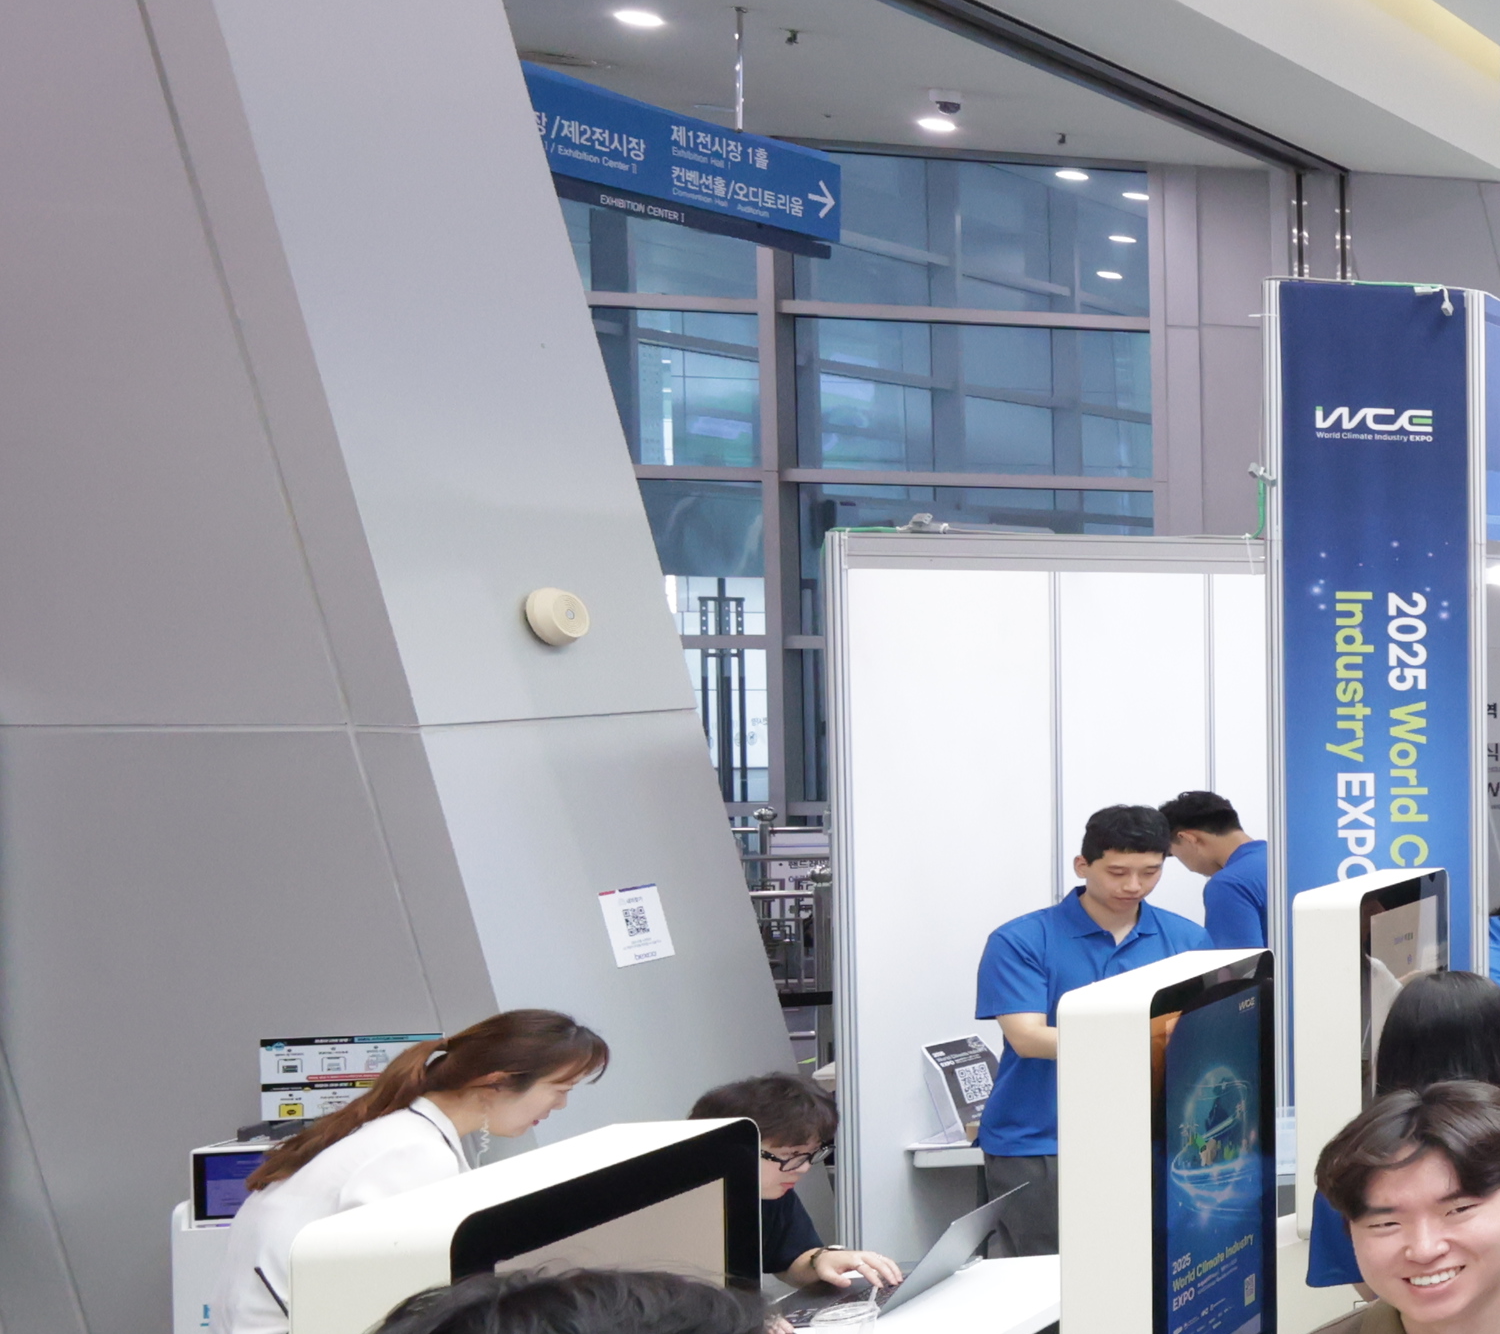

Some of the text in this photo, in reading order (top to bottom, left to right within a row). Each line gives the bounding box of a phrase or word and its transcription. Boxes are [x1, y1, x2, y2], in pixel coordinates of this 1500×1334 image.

[557, 144, 629, 172] Exhibition Center
[670, 125, 743, 163] 제1전시장
[747, 146, 769, 170] 1홀
[600, 194, 679, 221] EXHIBITION CENTER
[670, 165, 805, 218] 컨벤션홀/오디토리움
[1314, 405, 1434, 434] WCE
[1315, 431, 1434, 444] World Climate Industry EXPO
[1386, 591, 1428, 692] 2025
[1326, 590, 1377, 882] Industry EXPO
[1387, 700, 1430, 823] World
[1172, 1268, 1196, 1293] World
[1196, 1251, 1225, 1278] Climate
[1225, 1233, 1255, 1260] Industry
[1172, 1252, 1192, 1275] 2025
[1172, 1287, 1195, 1312] EXPO
